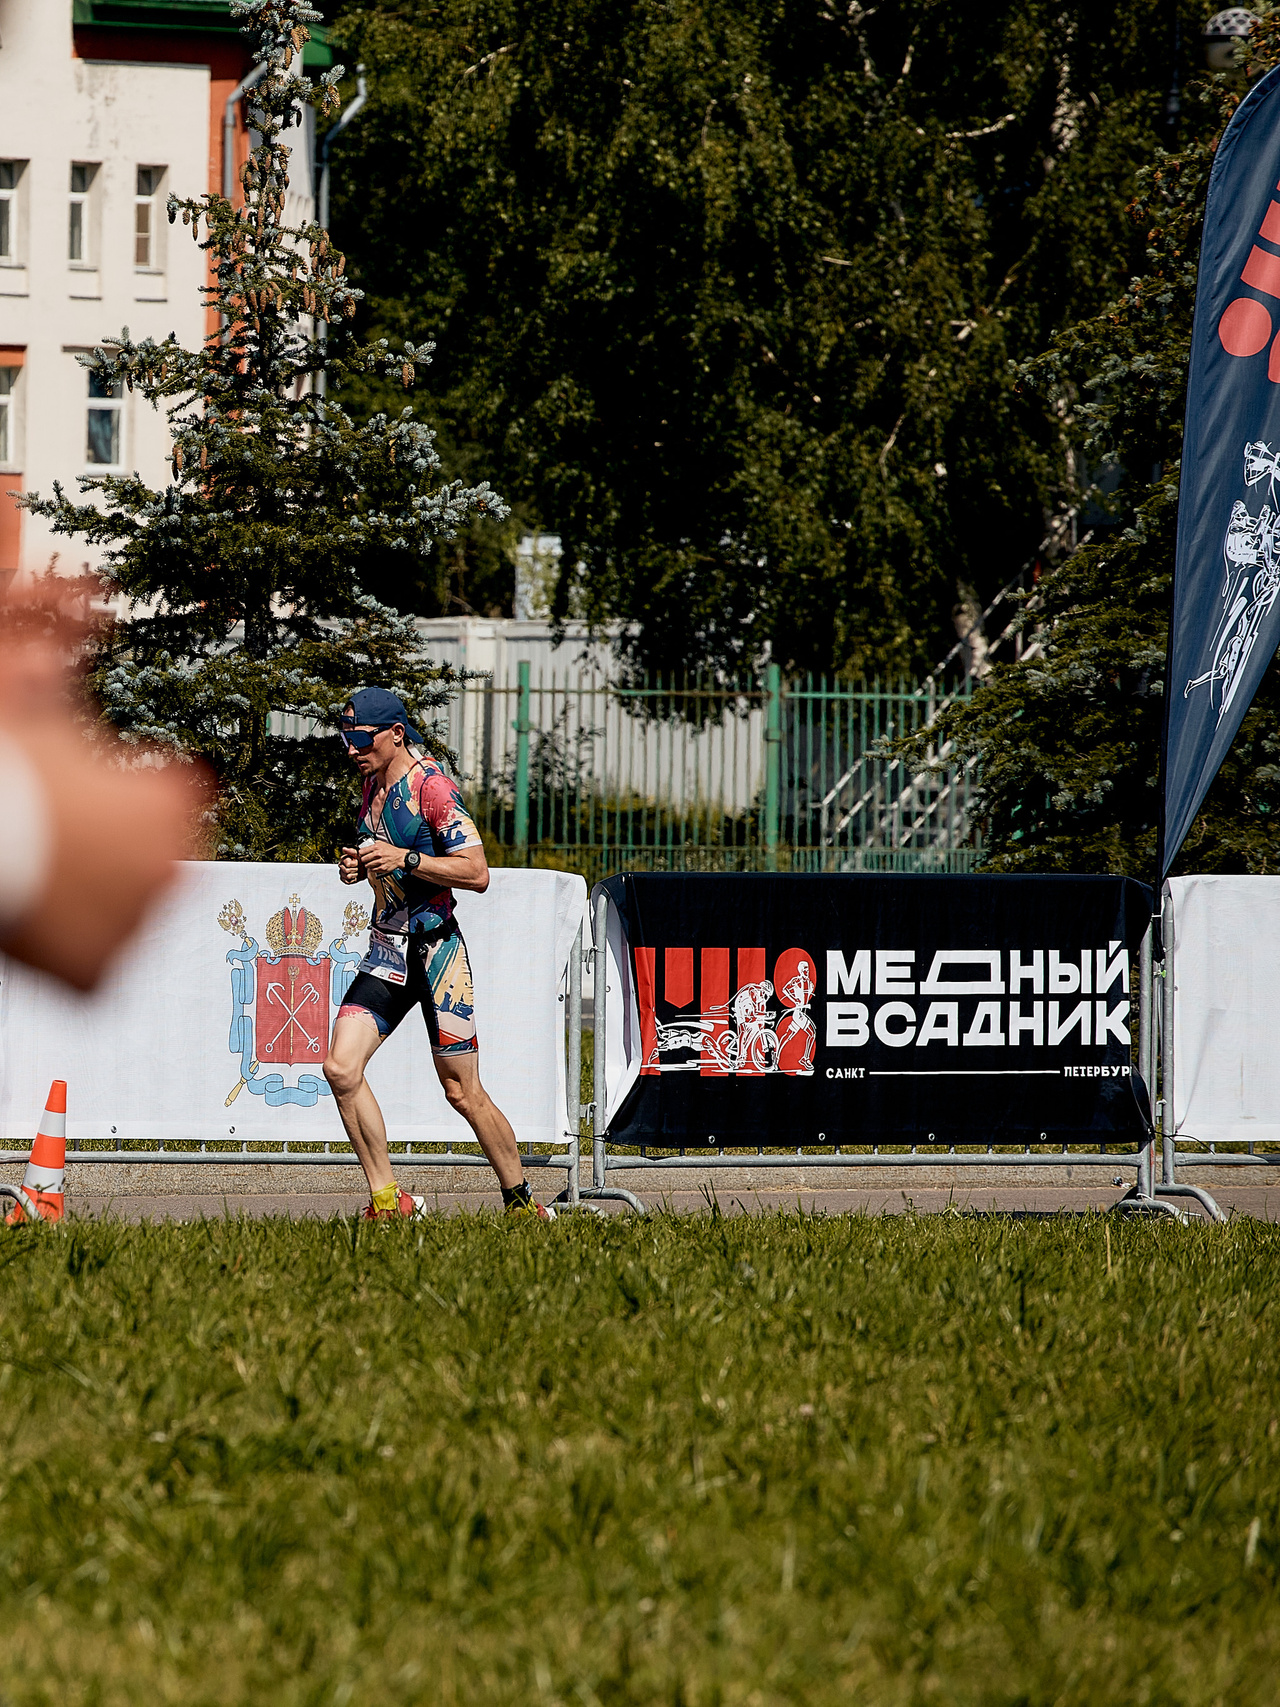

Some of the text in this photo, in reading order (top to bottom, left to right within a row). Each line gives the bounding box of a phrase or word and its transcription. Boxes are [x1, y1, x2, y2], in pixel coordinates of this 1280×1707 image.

[826, 940, 1130, 995] МЕДНЫЙ
[826, 1001, 1132, 1048] ВСАДНИК
[825, 1066, 1132, 1080] САНКТ ПЕТЕРБУР
